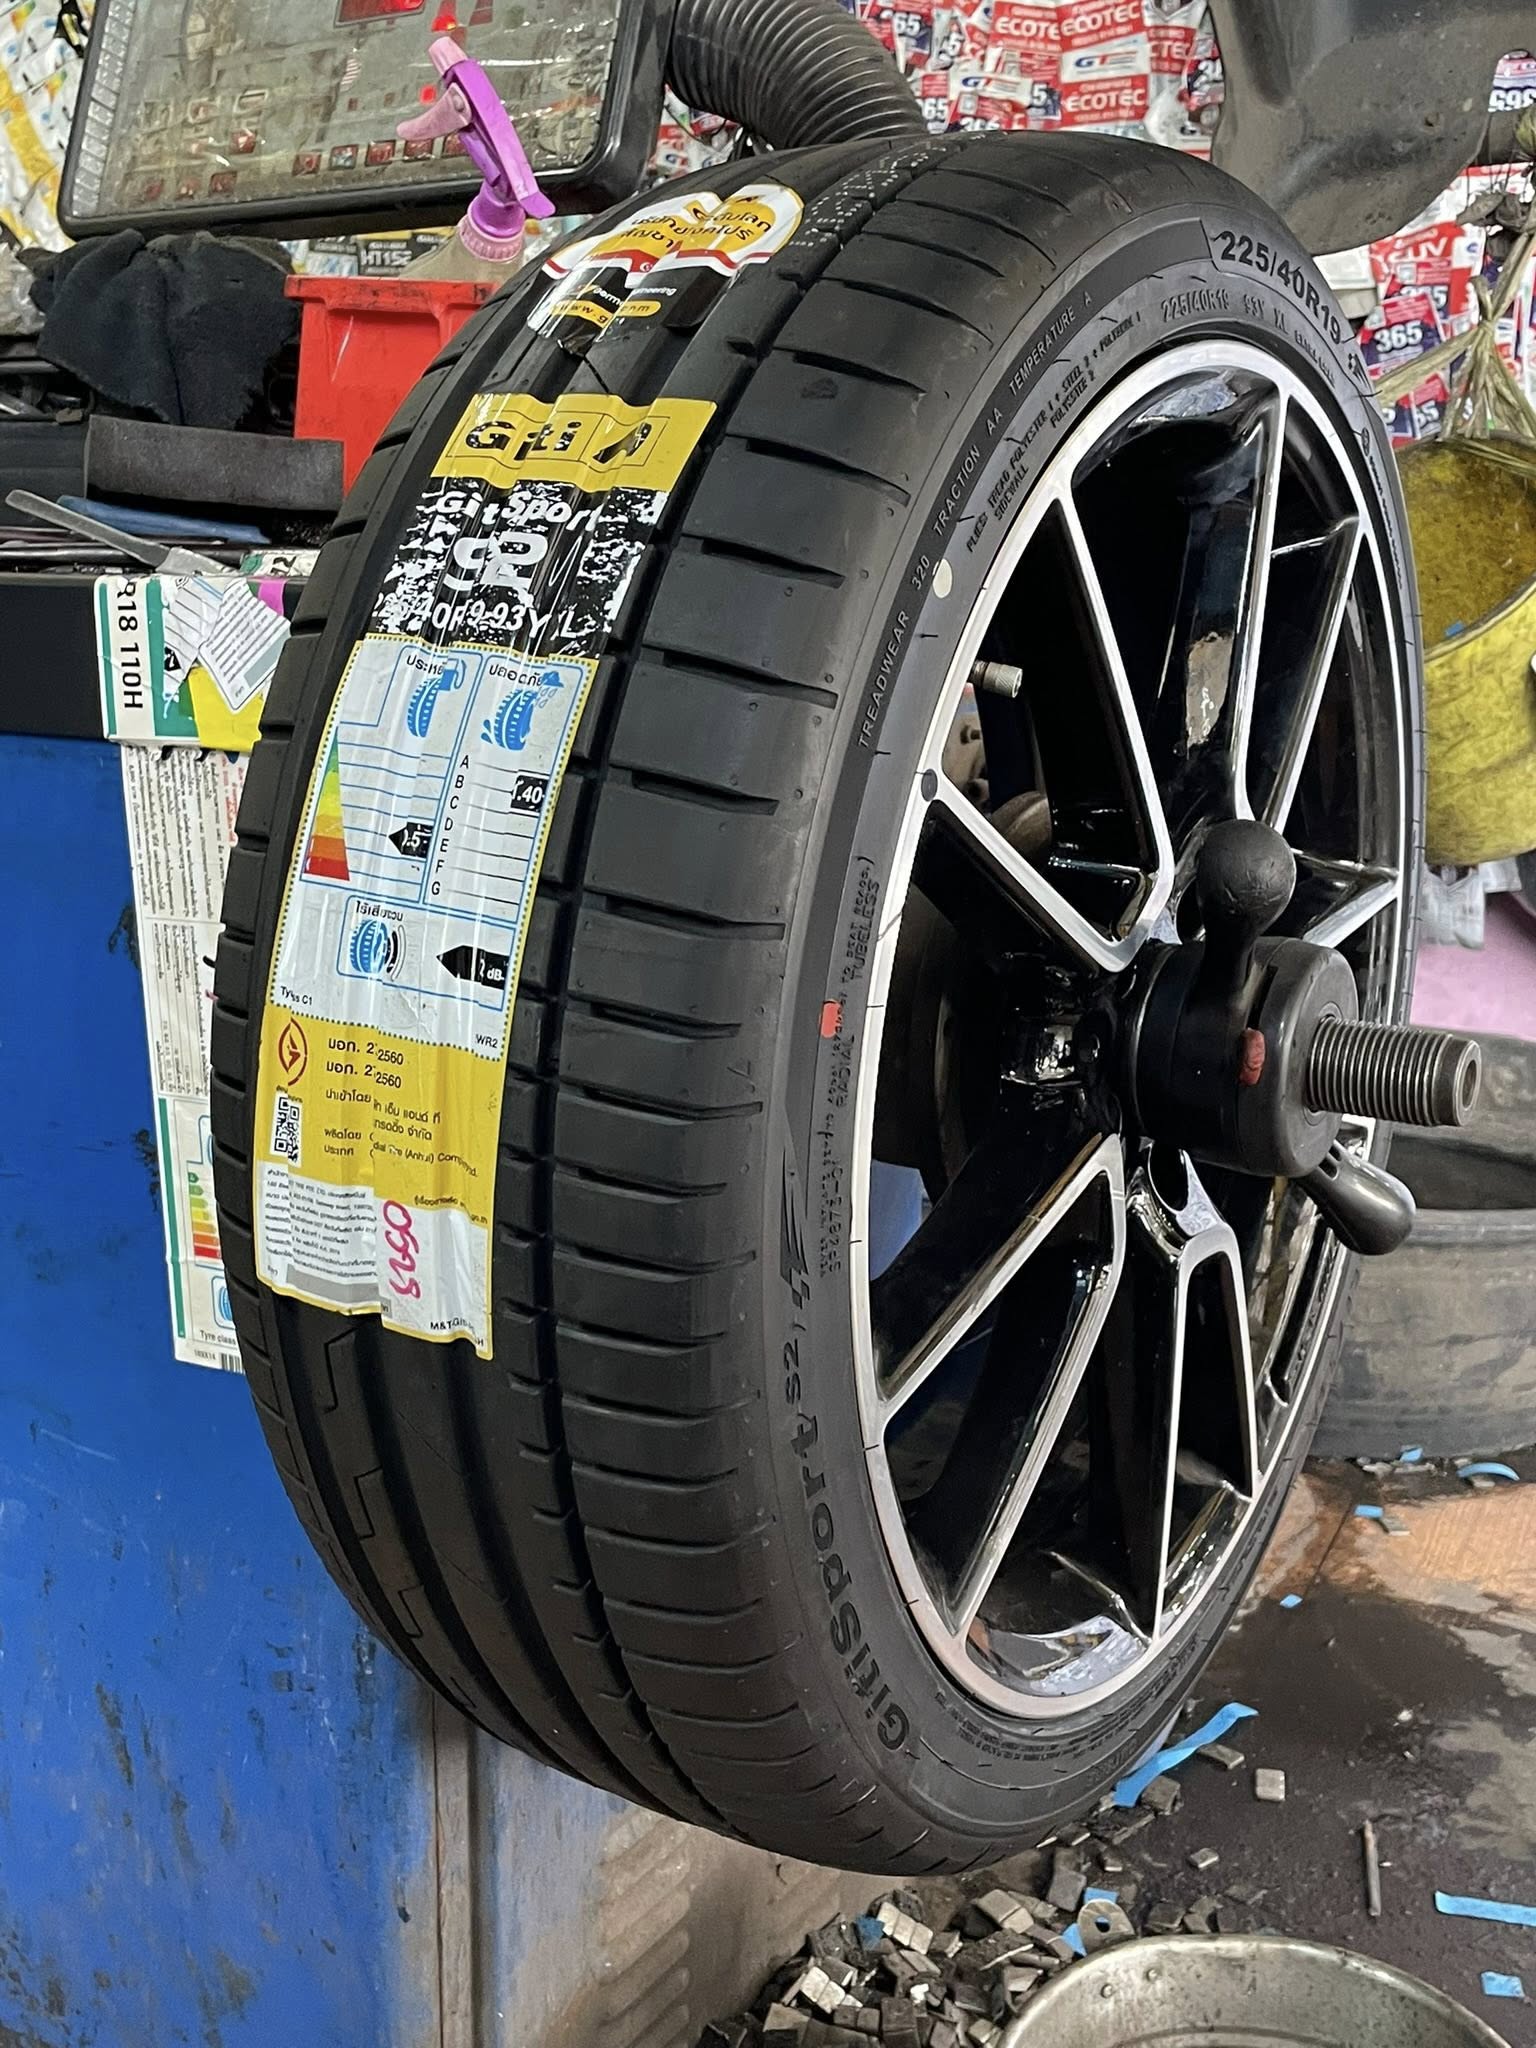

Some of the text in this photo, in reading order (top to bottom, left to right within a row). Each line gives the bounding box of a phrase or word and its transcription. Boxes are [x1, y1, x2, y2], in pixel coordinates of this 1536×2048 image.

[1061, 3, 1140, 37] ECOTEC
[1065, 88, 1146, 113] ECOTEC
[1219, 230, 1341, 345] 225/40R19
[1375, 320, 1425, 353] 365
[465, 419, 582, 461] Giti
[857, 290, 1094, 750] TREADWEAR 320 TRACTION AA TEMPERATURE A
[119, 641, 144, 709] 110H
[459, 754, 471, 770] A
[454, 774, 465, 790] B
[449, 795, 460, 811] C
[444, 816, 454, 832] D
[439, 838, 450, 854] E
[434, 859, 446, 874] F
[430, 881, 441, 896] G
[849, 878, 880, 981] TUBELESS
[474, 1033, 498, 1049] WR2
[783, 1337, 911, 1751] GitiSport S2
